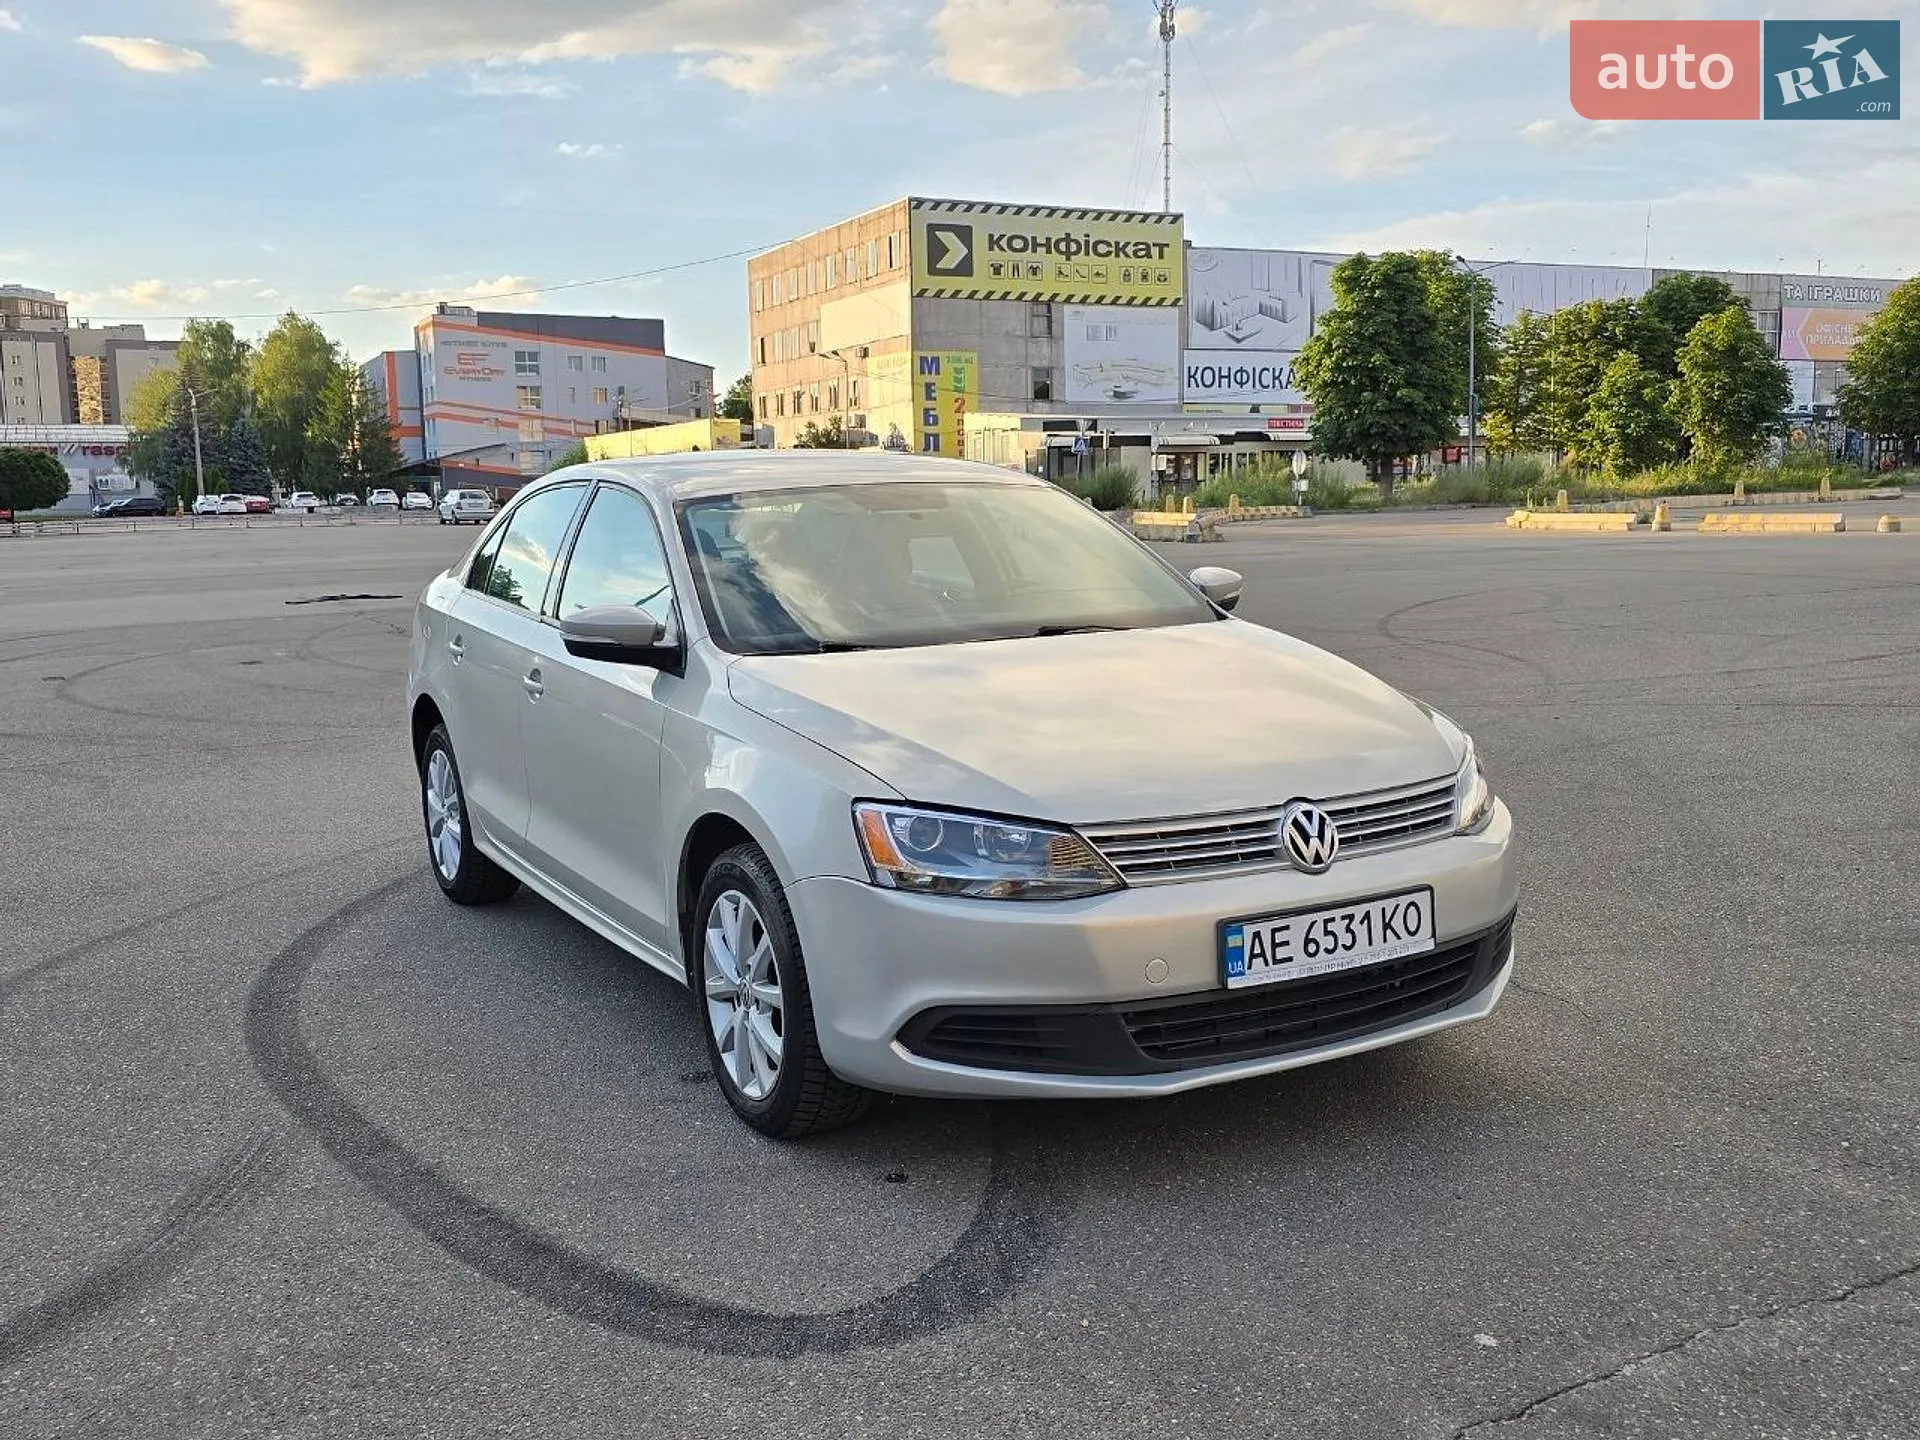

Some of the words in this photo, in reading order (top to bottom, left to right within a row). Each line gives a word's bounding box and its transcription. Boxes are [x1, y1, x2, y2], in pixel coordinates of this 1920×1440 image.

[987, 232, 1170, 262] конфіскат
[1783, 284, 1804, 300] ТА
[1807, 285, 1881, 302] ІГРАШКИ
[1186, 365, 1296, 390] КОНФІСКА
[919, 356, 941, 452] МЕБЛ
[1247, 924, 1293, 970] AE
[1302, 910, 1373, 958] 6531
[1381, 900, 1422, 944] KO
[1229, 961, 1245, 974] UA
